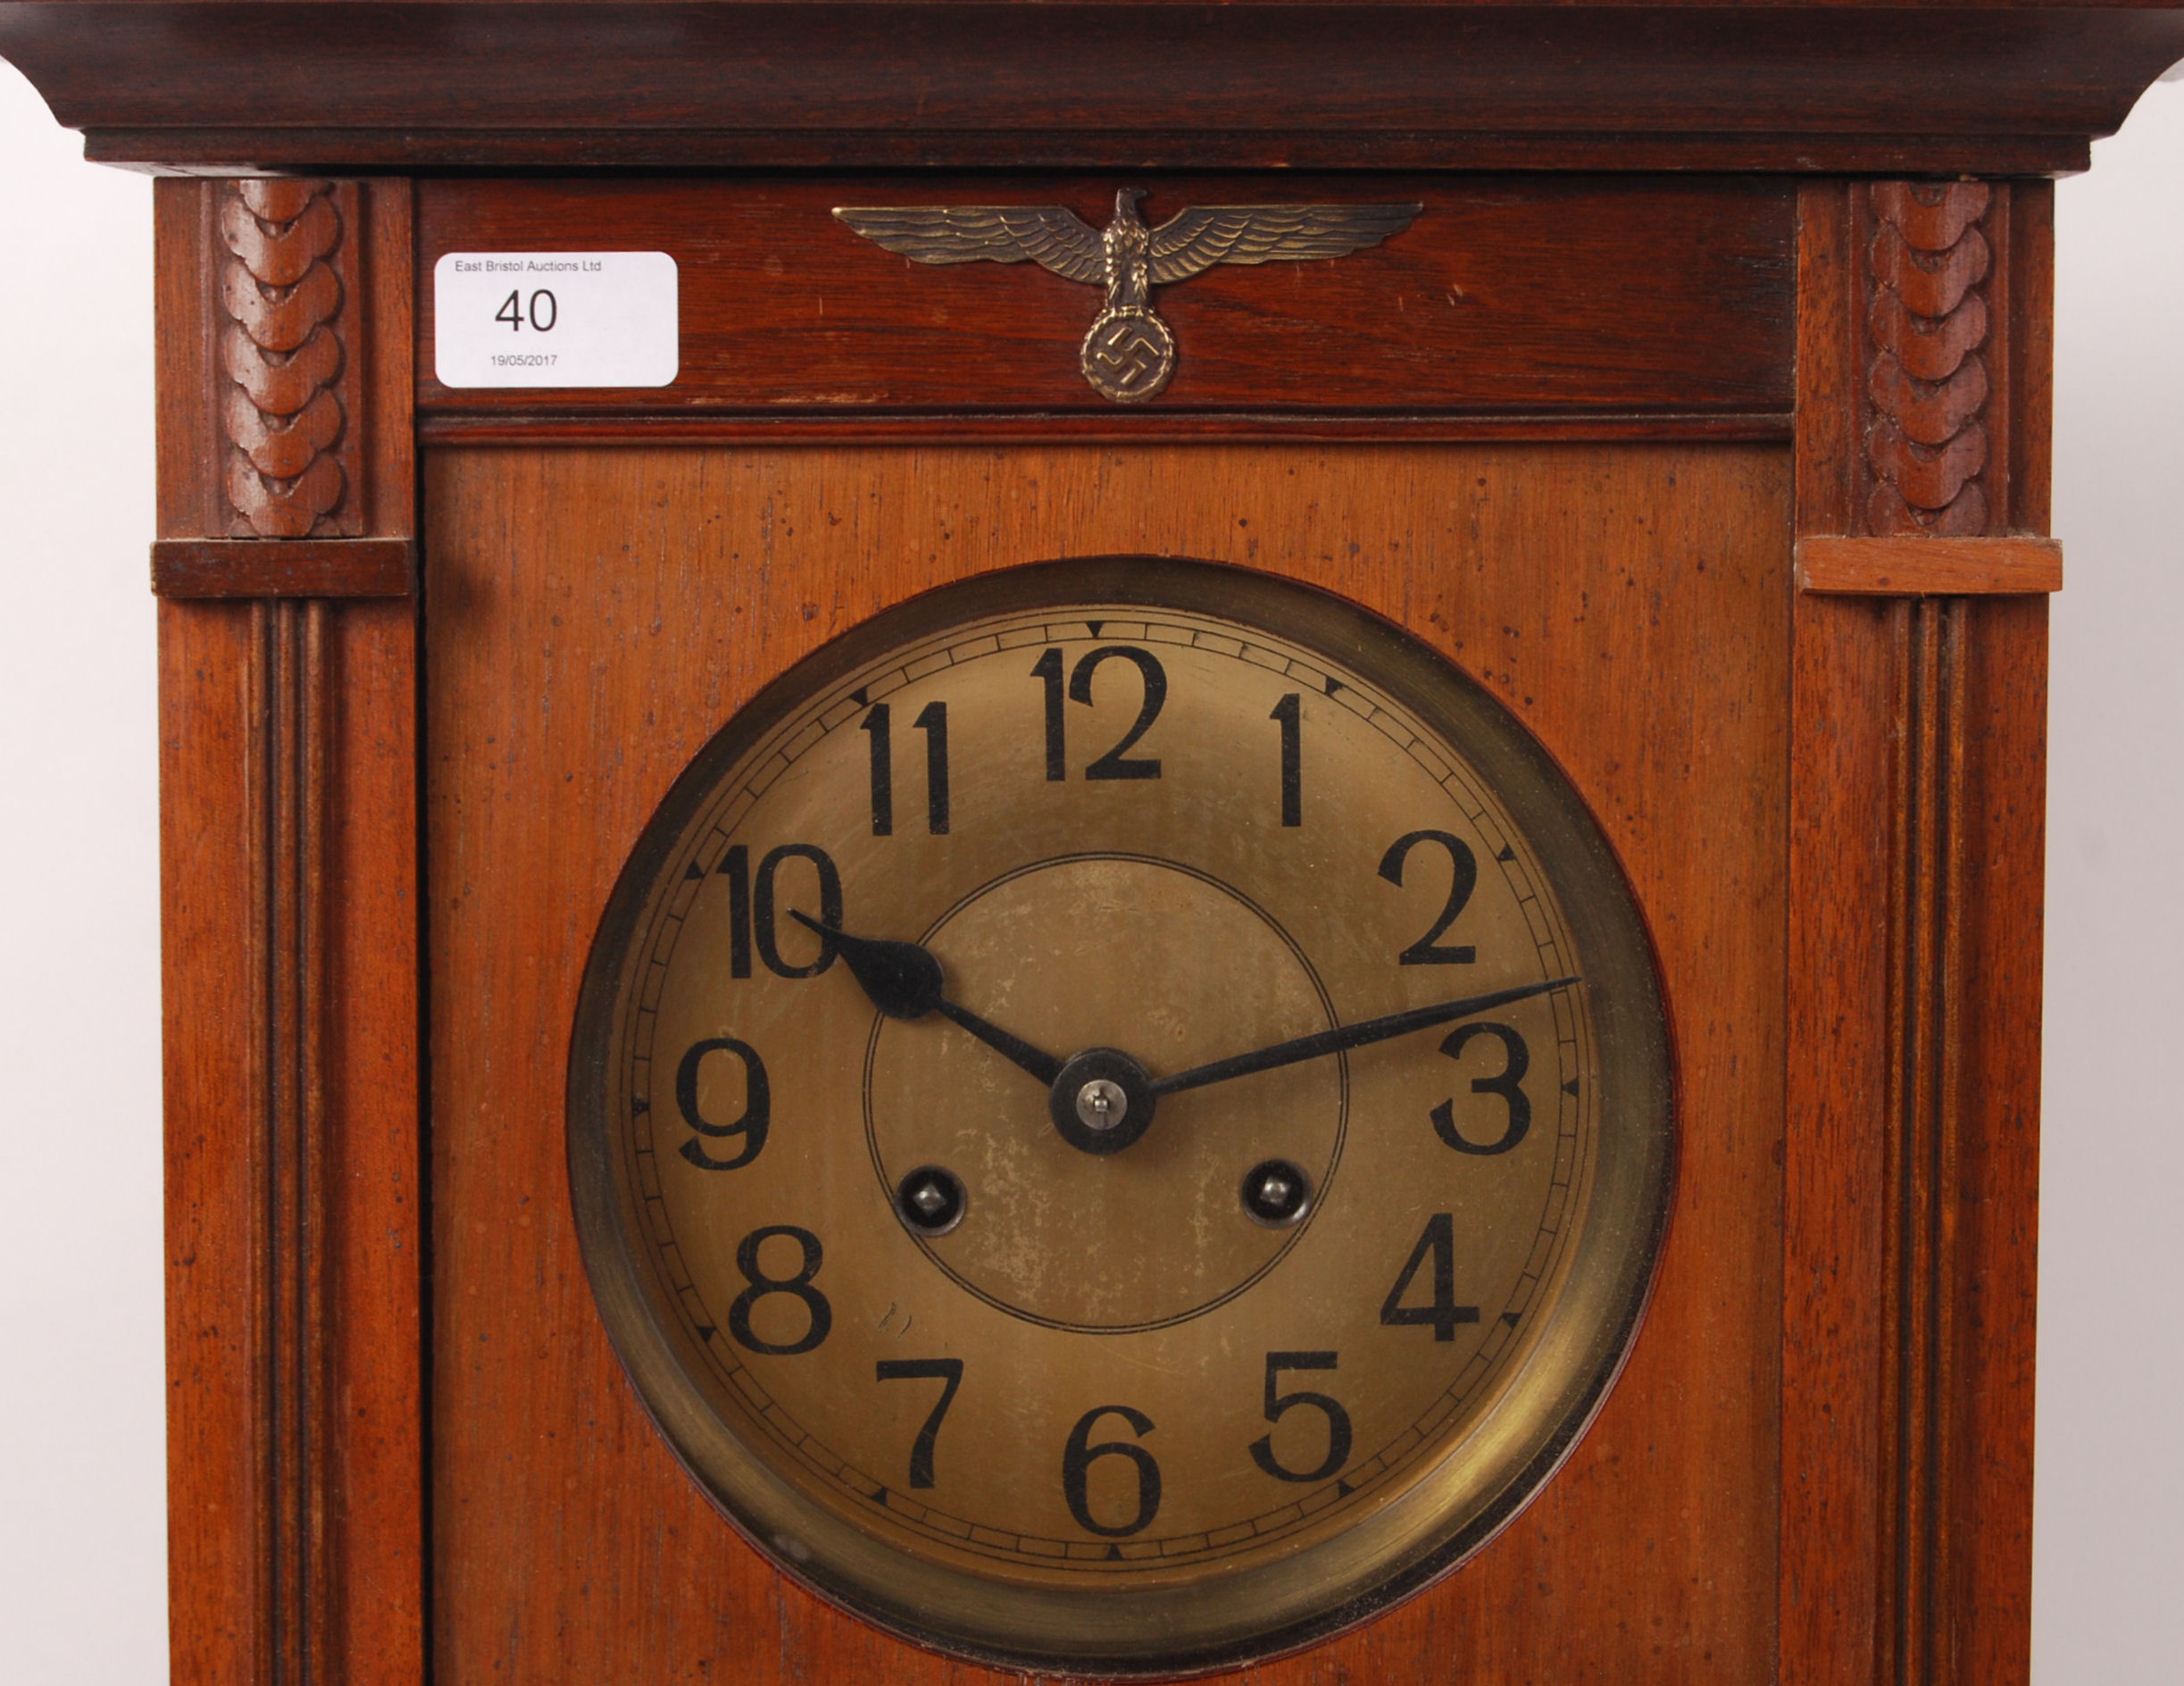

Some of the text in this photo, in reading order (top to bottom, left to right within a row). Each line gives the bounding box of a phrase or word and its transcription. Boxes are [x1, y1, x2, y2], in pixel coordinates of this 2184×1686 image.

[455, 260, 602, 272] East Bristol Auctions Ltd
[495, 288, 557, 333] 40
[491, 355, 558, 367] 19/05/2017
[860, 701, 949, 836] 11
[1029, 645, 1167, 781] 12
[1269, 693, 1303, 827] 1
[716, 844, 843, 979] 10
[1378, 830, 1479, 965] 2
[675, 1038, 771, 1172] 9
[1430, 1022, 1532, 1156] 3
[728, 1224, 833, 1356] 8
[1379, 1212, 1480, 1343] 4
[875, 1358, 965, 1490] 7
[1062, 1405, 1163, 1539] 6
[1247, 1350, 1354, 1484] 5
